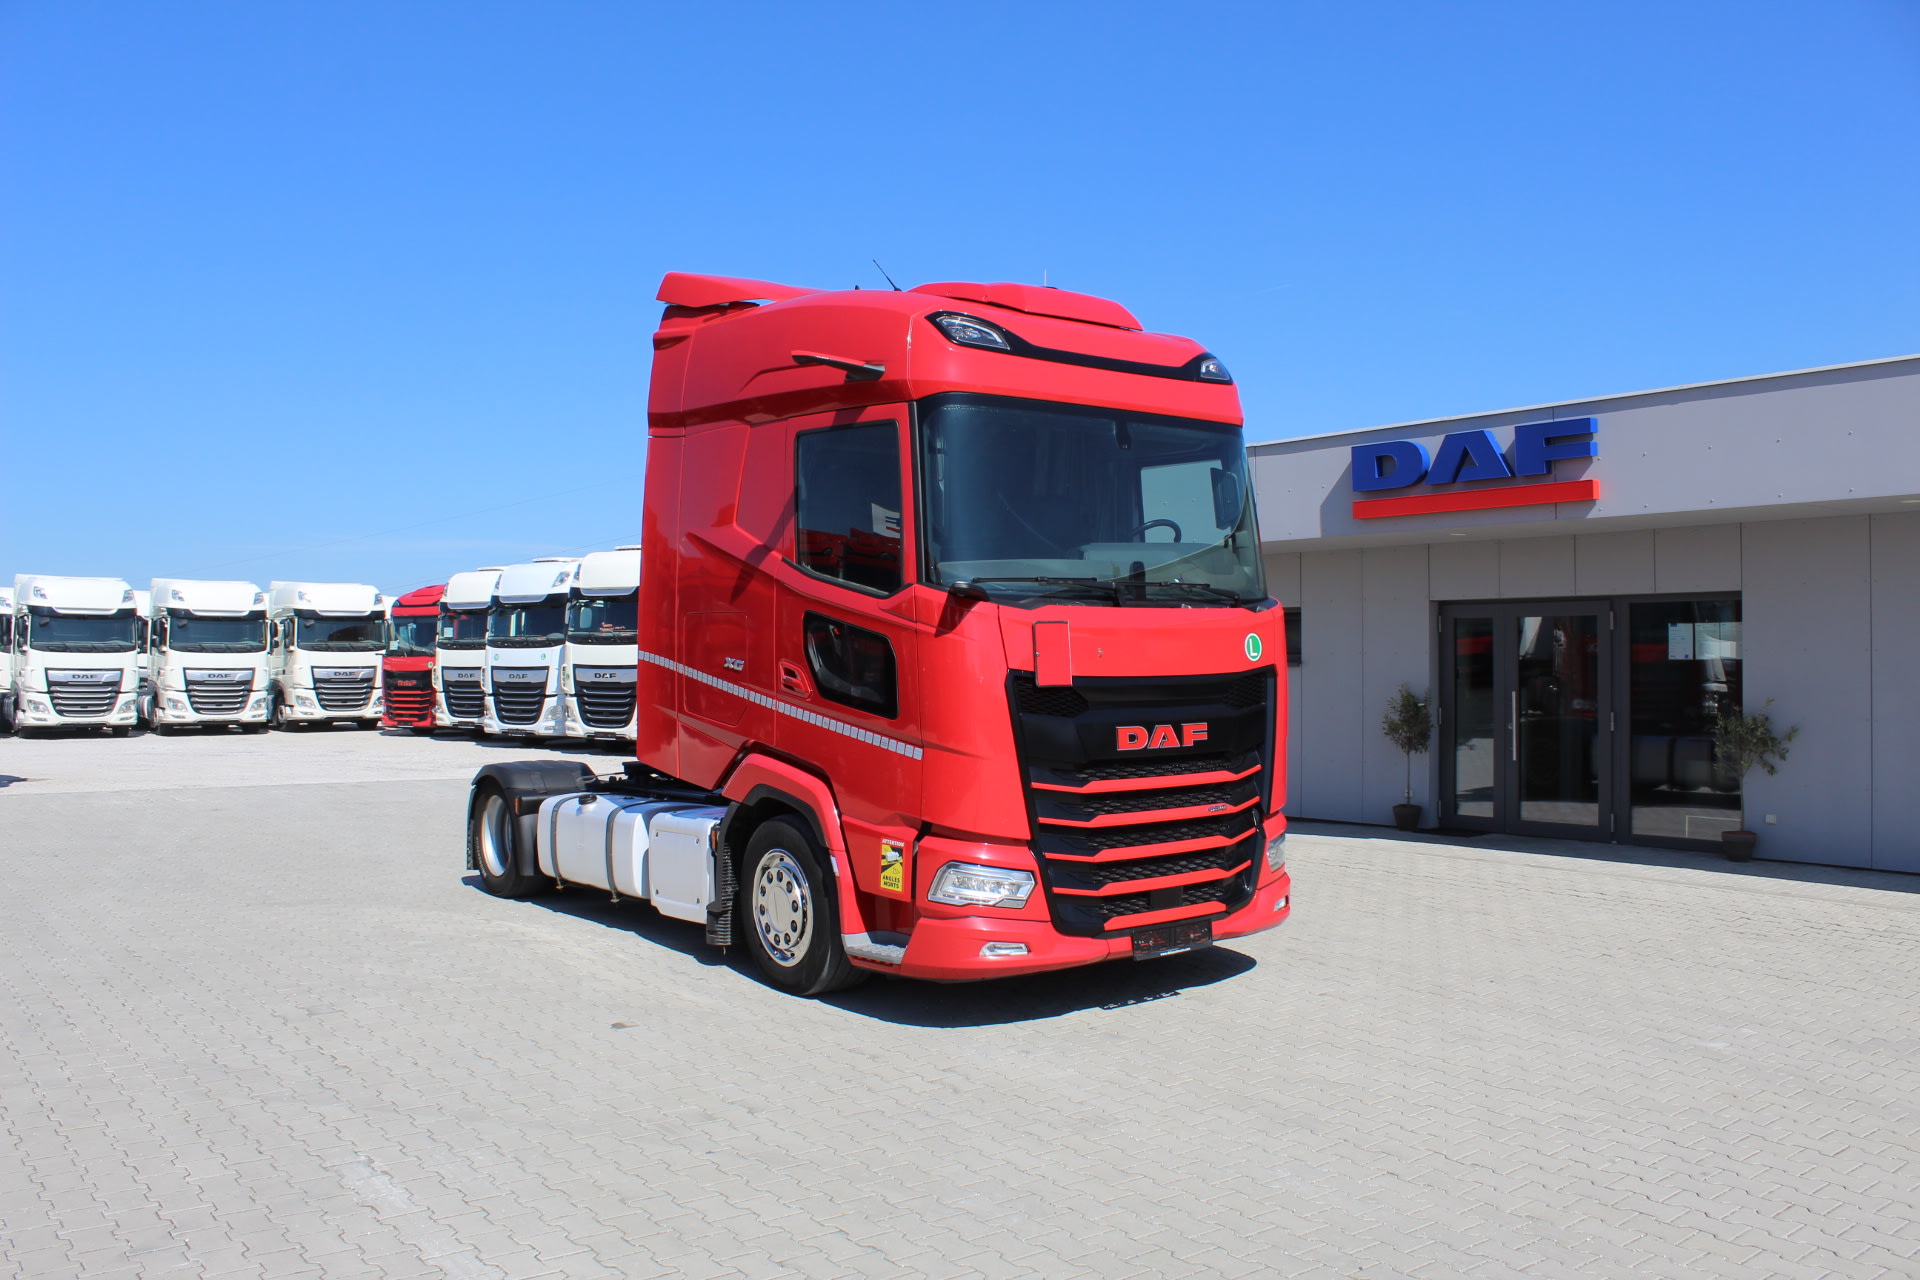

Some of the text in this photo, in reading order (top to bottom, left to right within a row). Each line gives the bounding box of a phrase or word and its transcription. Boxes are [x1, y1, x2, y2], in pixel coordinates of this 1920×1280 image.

[1351, 417, 1598, 492] DAF
[1249, 638, 1258, 657] L
[723, 656, 745, 671] XG
[1116, 722, 1208, 751] DAF
[882, 839, 904, 847] ATTENTION
[883, 875, 900, 883] ANGLES
[884, 881, 899, 889] MORTS
